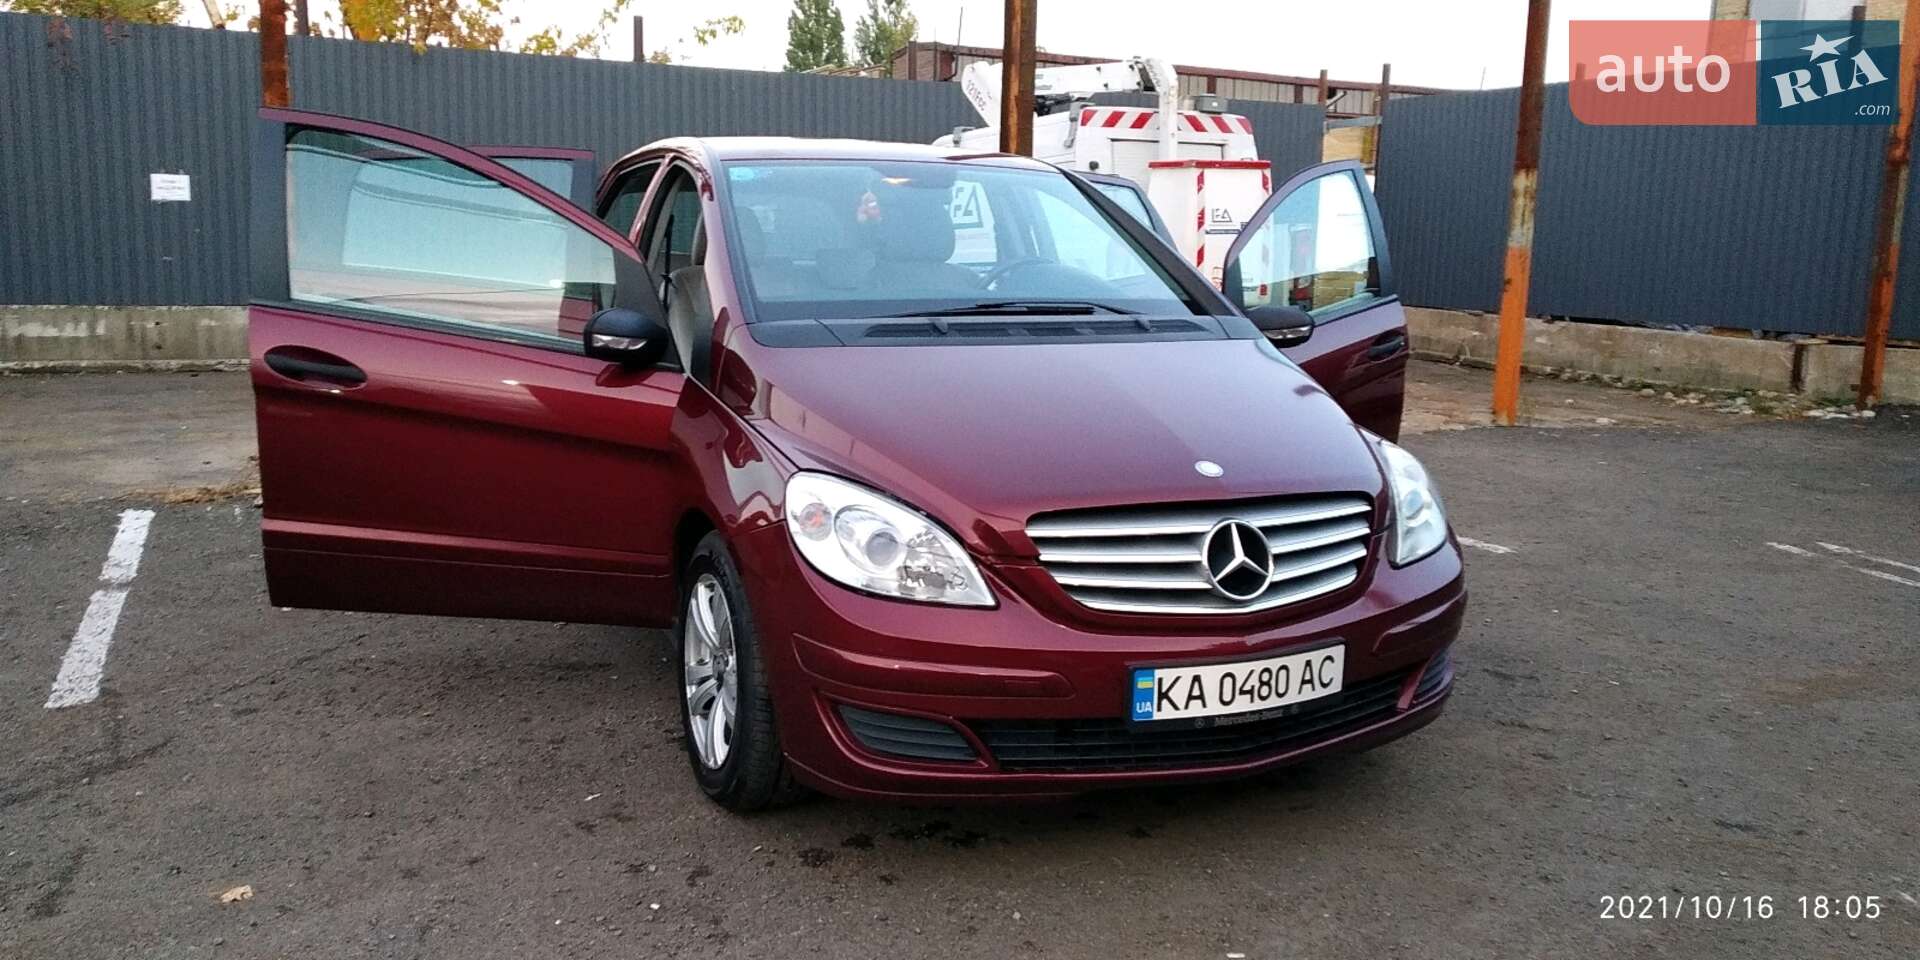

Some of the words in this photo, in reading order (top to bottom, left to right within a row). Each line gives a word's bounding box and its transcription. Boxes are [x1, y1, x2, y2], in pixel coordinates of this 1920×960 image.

[1156, 674, 1208, 712] KA
[1218, 664, 1290, 706] 0480
[1298, 655, 1335, 695] AC
[1136, 702, 1153, 713] UA
